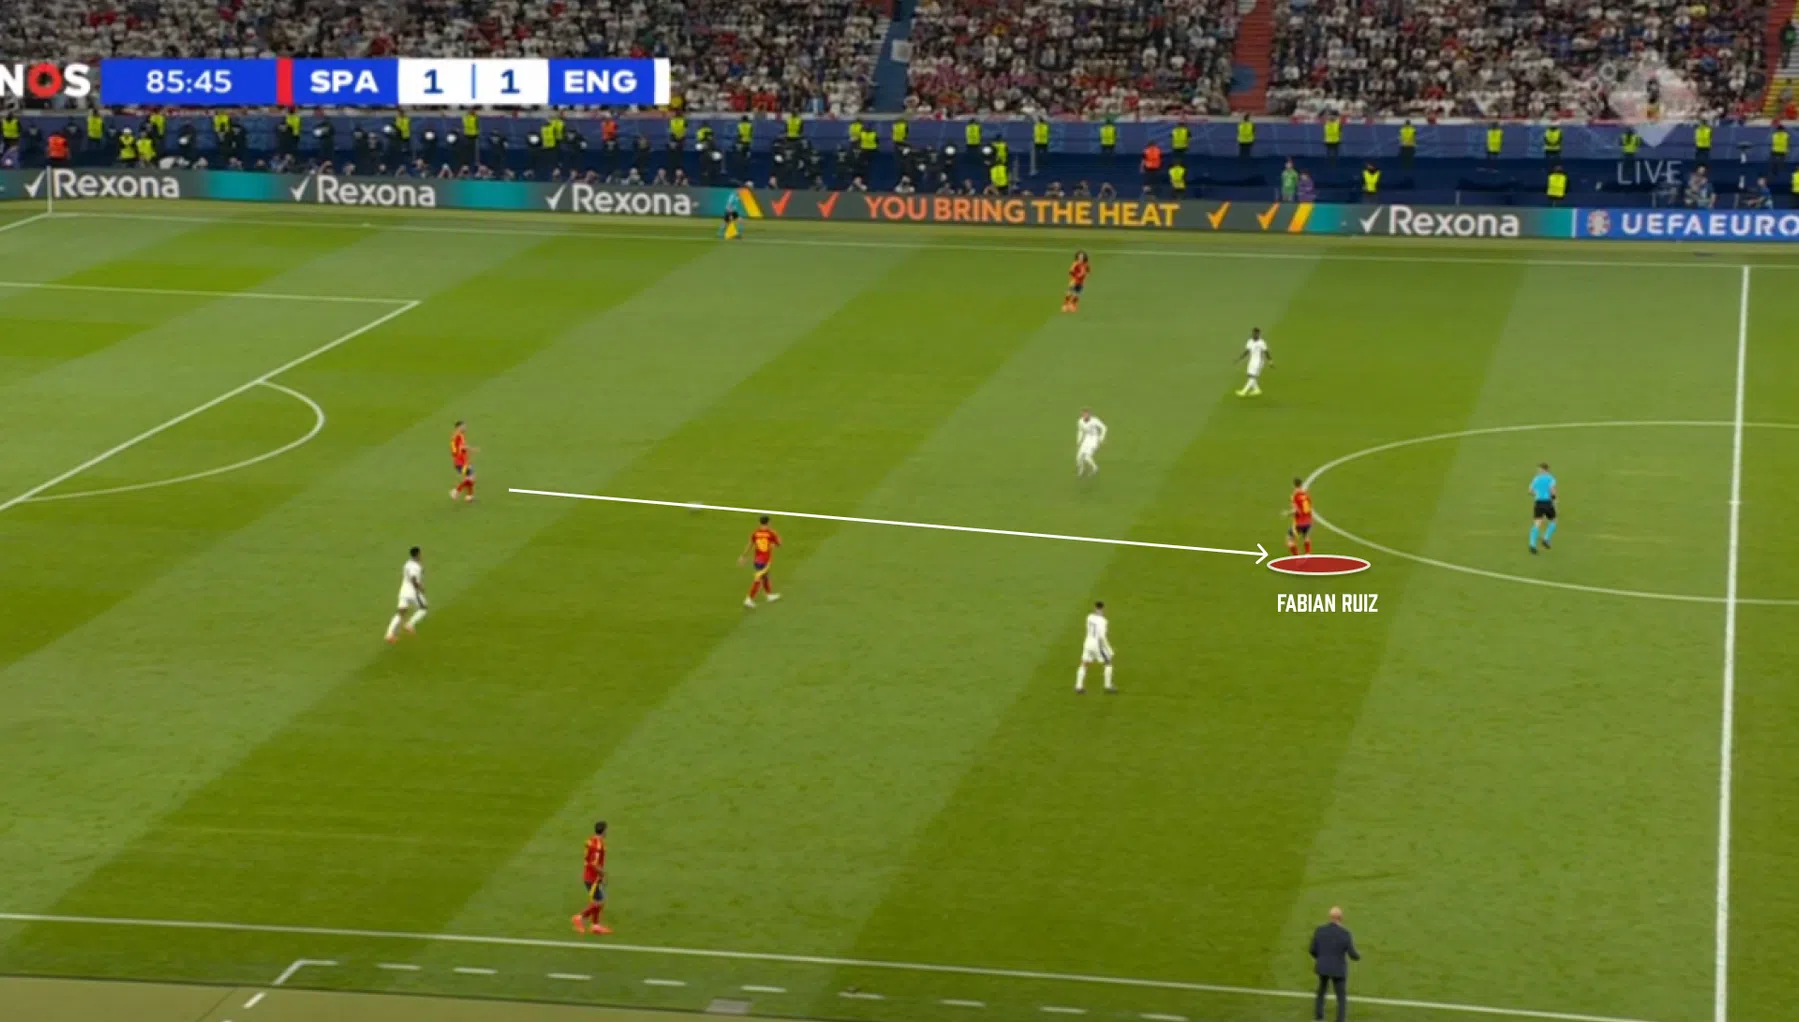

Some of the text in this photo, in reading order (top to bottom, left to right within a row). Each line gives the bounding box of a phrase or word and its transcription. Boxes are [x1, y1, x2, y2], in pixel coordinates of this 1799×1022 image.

[54, 169, 180, 199] Rexona
[317, 175, 436, 208] Rexona
[571, 183, 692, 216] Rexona
[864, 195, 1179, 227] YOU BRING THE HEAT
[1388, 204, 1519, 237] Rexona
